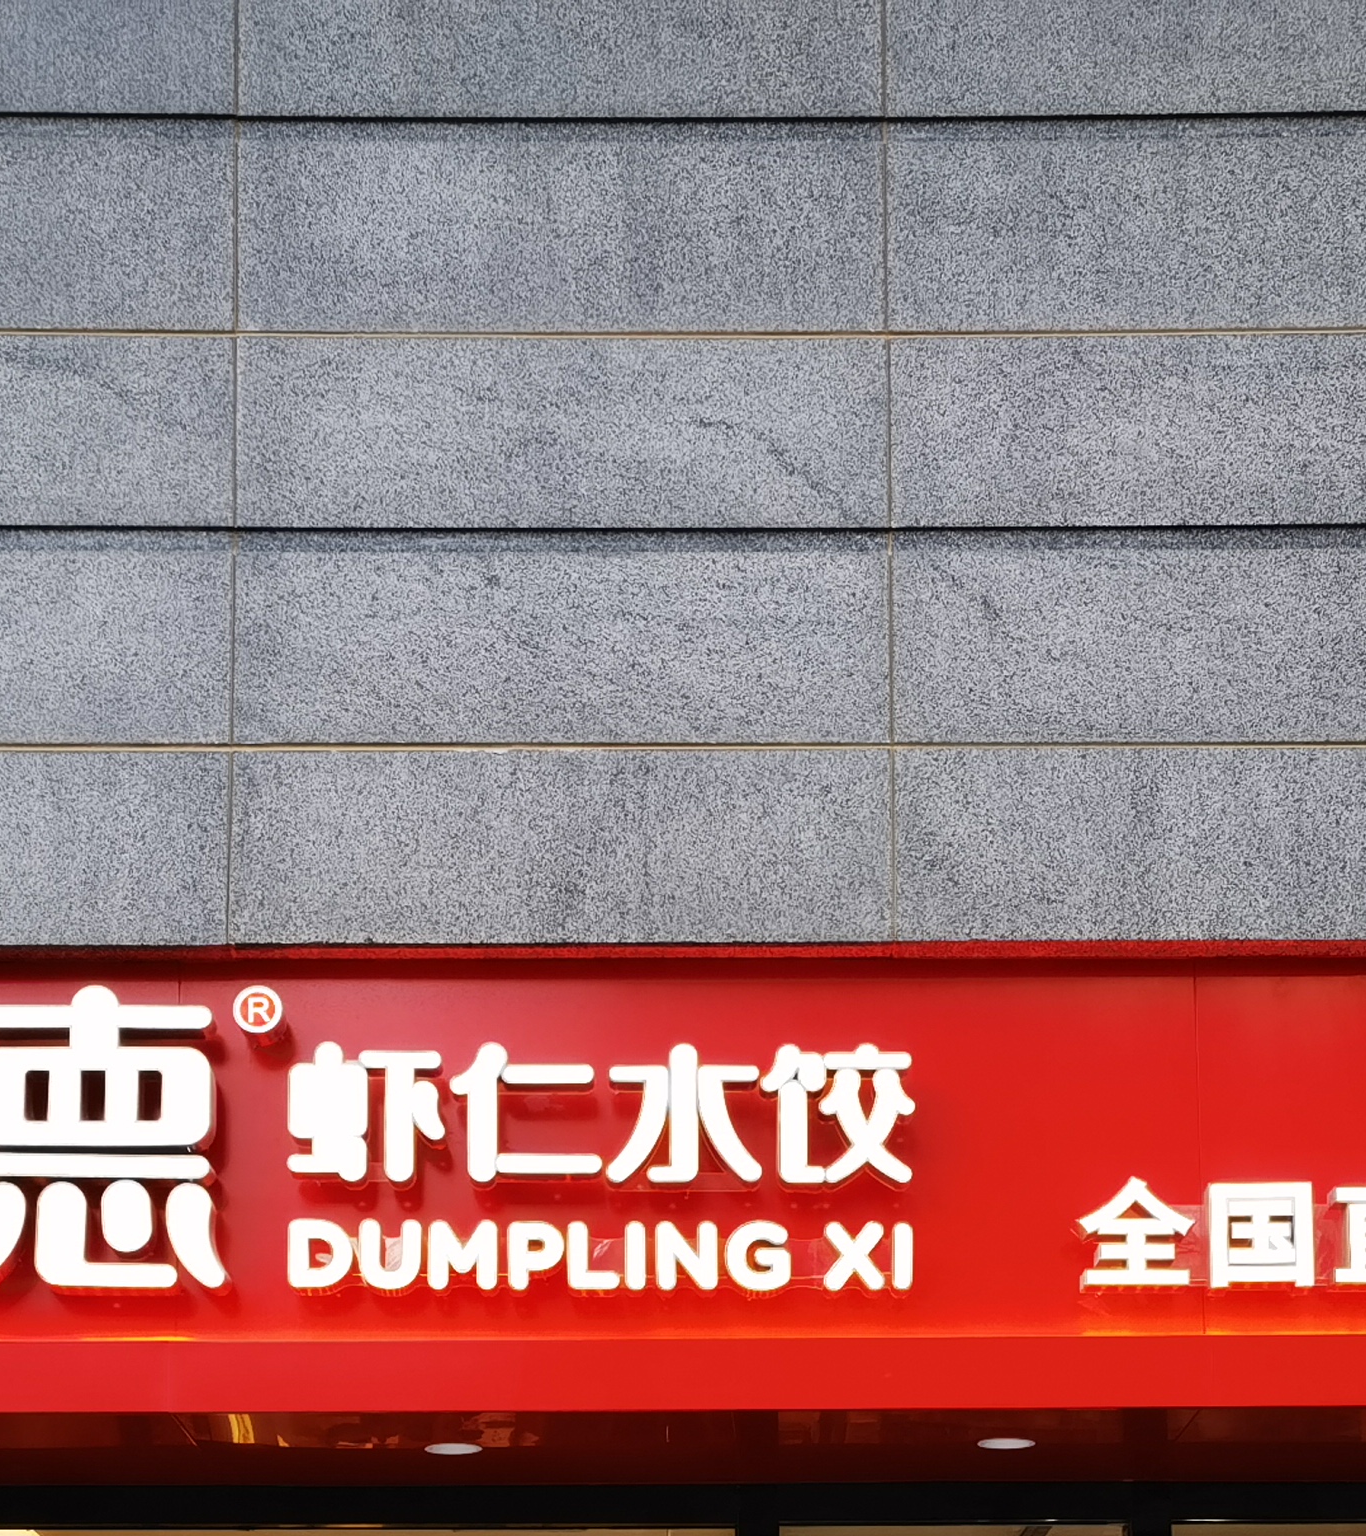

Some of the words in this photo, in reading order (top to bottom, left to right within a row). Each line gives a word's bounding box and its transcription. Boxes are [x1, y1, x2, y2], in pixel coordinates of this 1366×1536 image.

[287, 1042, 916, 1184] 虾仁水饺
[287, 1219, 792, 1292] DUMPLING
[823, 1221, 914, 1291] XI
